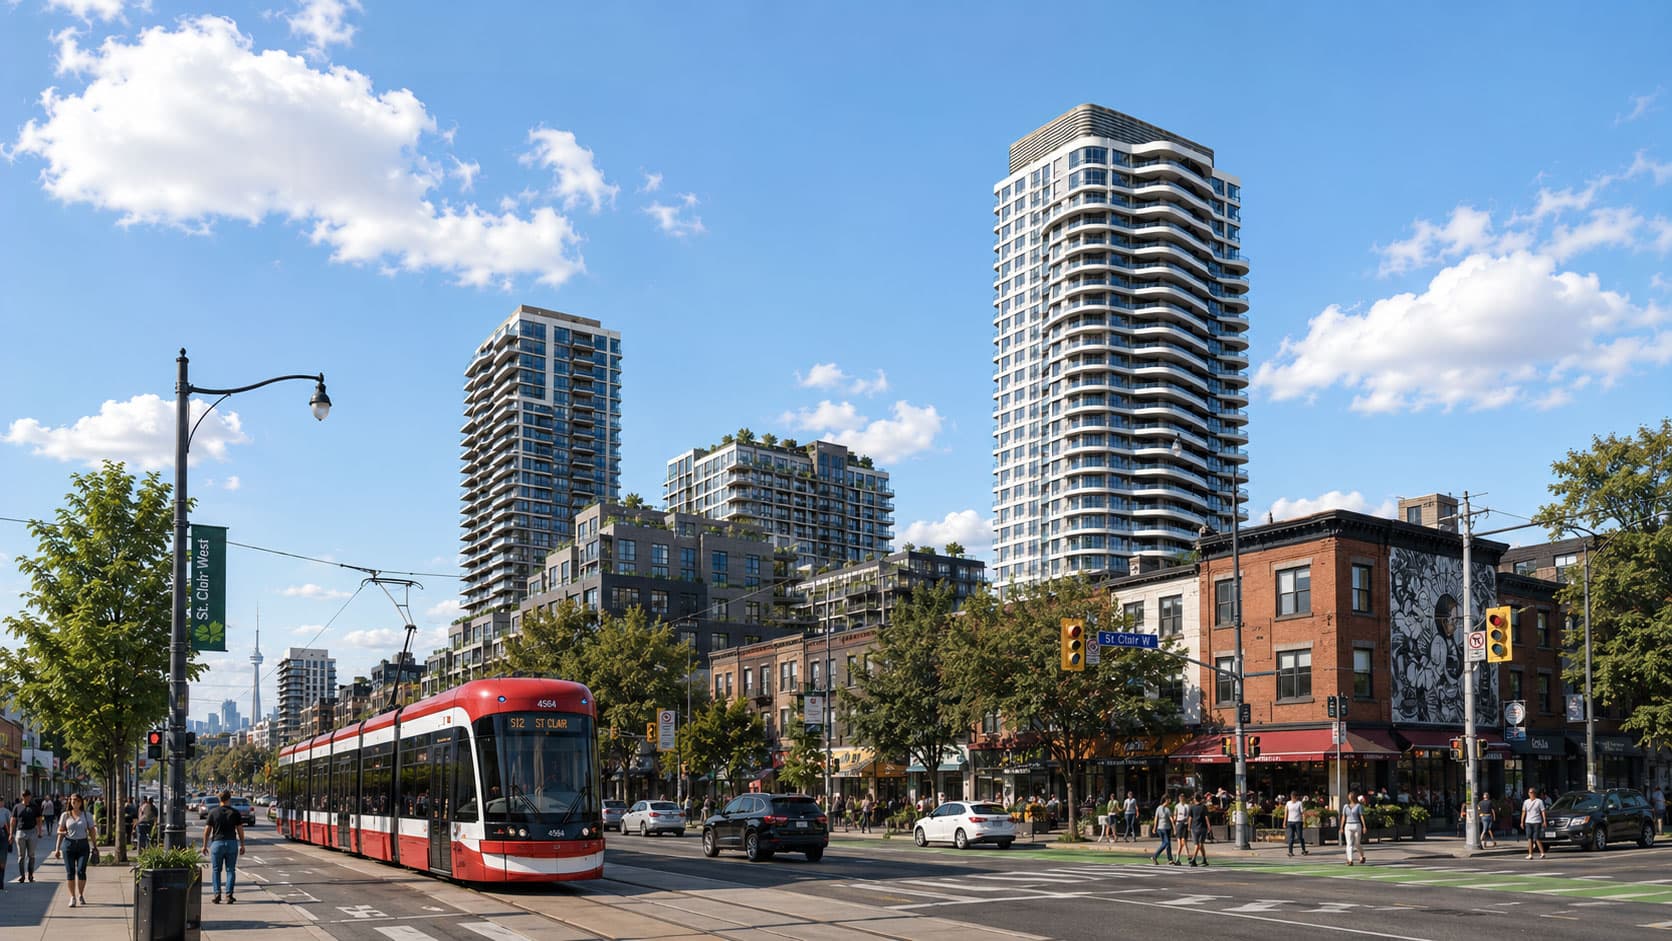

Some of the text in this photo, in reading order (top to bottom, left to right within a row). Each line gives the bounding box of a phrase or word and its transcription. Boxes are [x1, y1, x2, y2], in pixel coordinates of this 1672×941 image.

[196, 538, 209, 569] West
[196, 603, 209, 621] St.
[1141, 635, 1151, 646] W
[535, 718, 545, 728] ST
